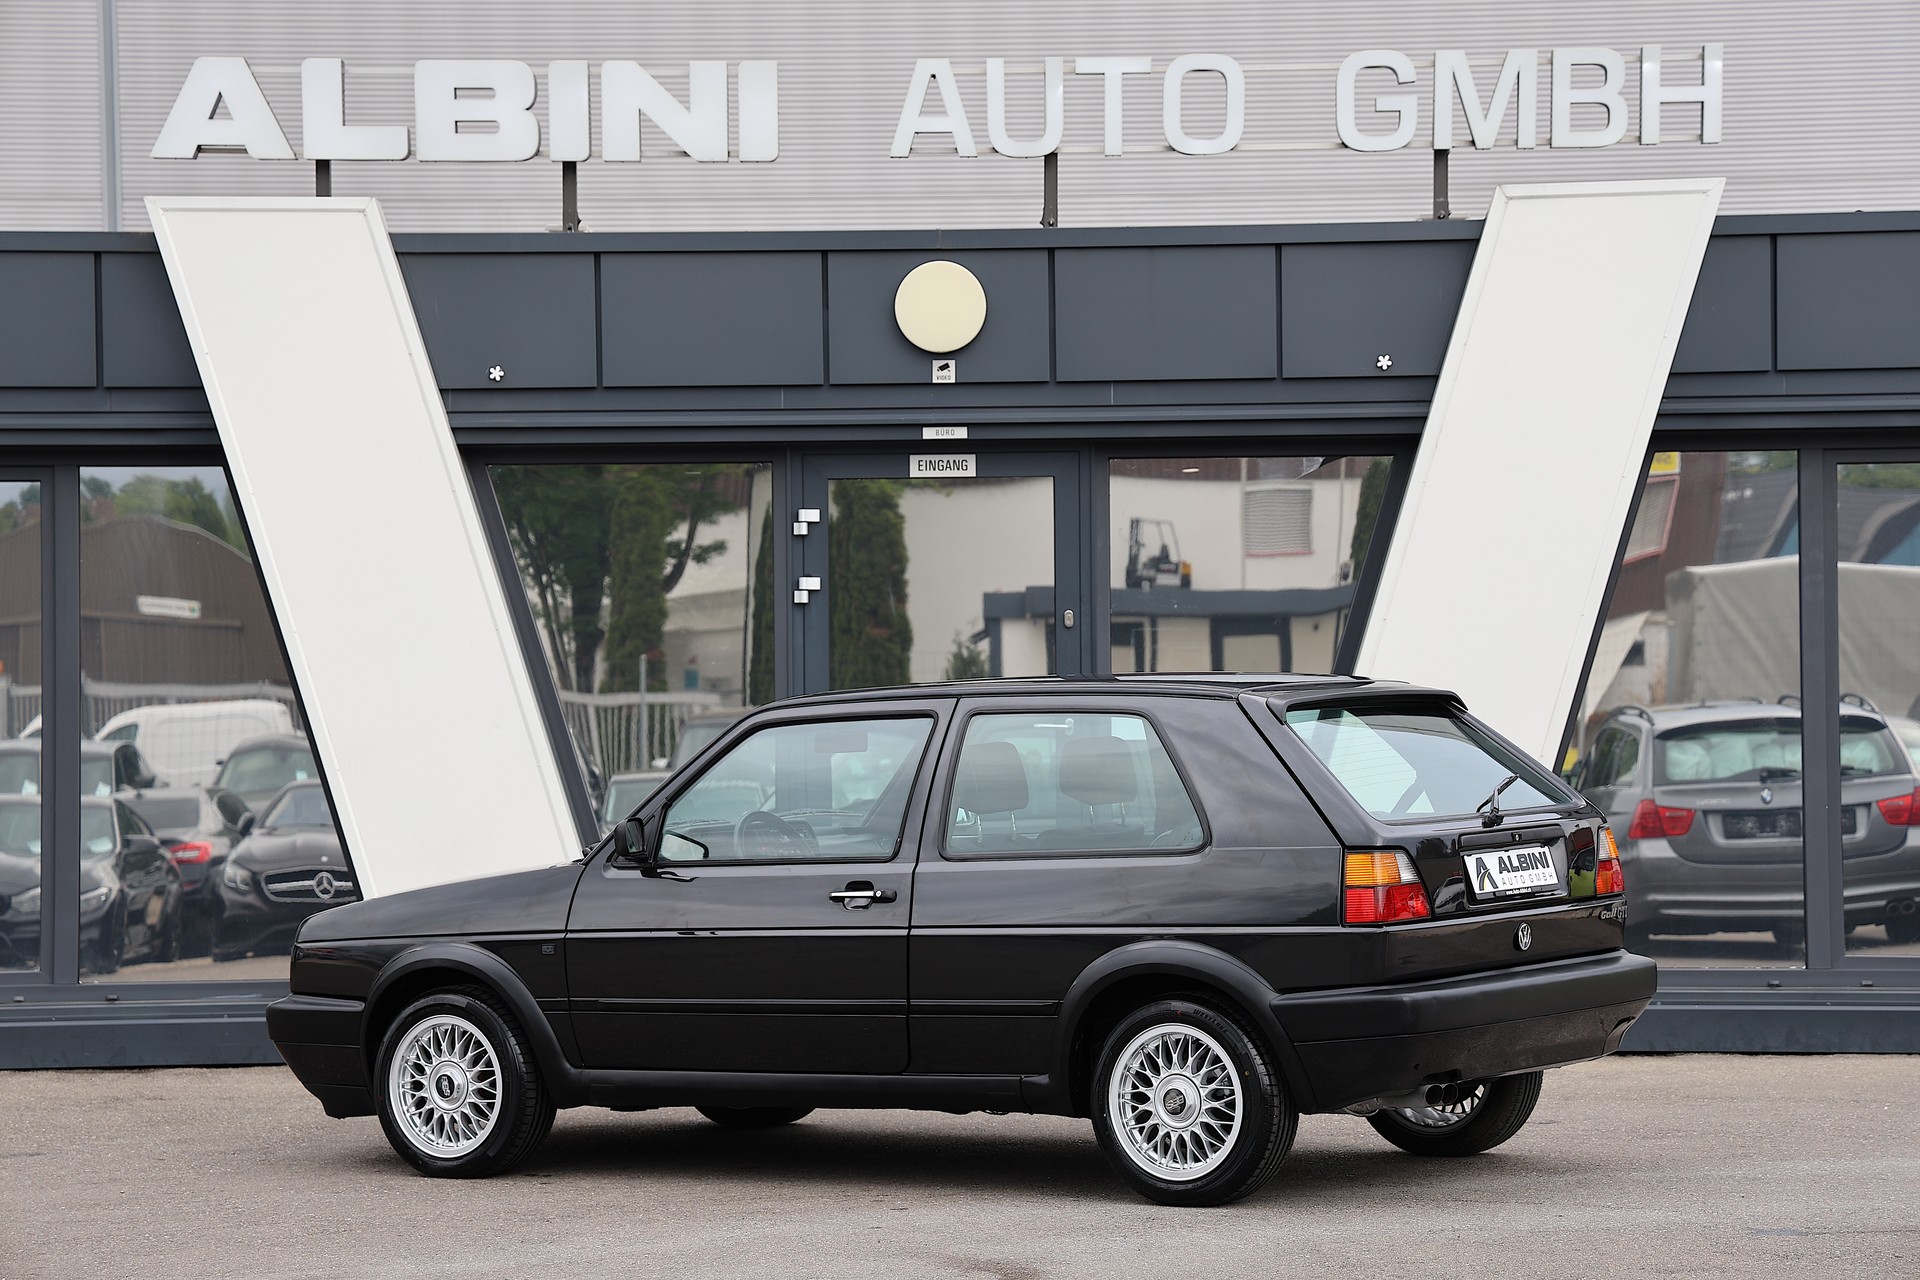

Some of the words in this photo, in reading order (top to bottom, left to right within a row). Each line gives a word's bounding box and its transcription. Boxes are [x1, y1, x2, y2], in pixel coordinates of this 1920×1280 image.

[150, 56, 780, 163] ALBINI
[890, 53, 1246, 159] AUTO
[1336, 42, 1723, 152] GMBH
[935, 428, 955, 436] BÜRO
[917, 459, 968, 472] EINGANG
[1498, 851, 1550, 874] ALBINI
[1501, 875, 1526, 886] AUTO
[1528, 872, 1554, 882] GMBH
